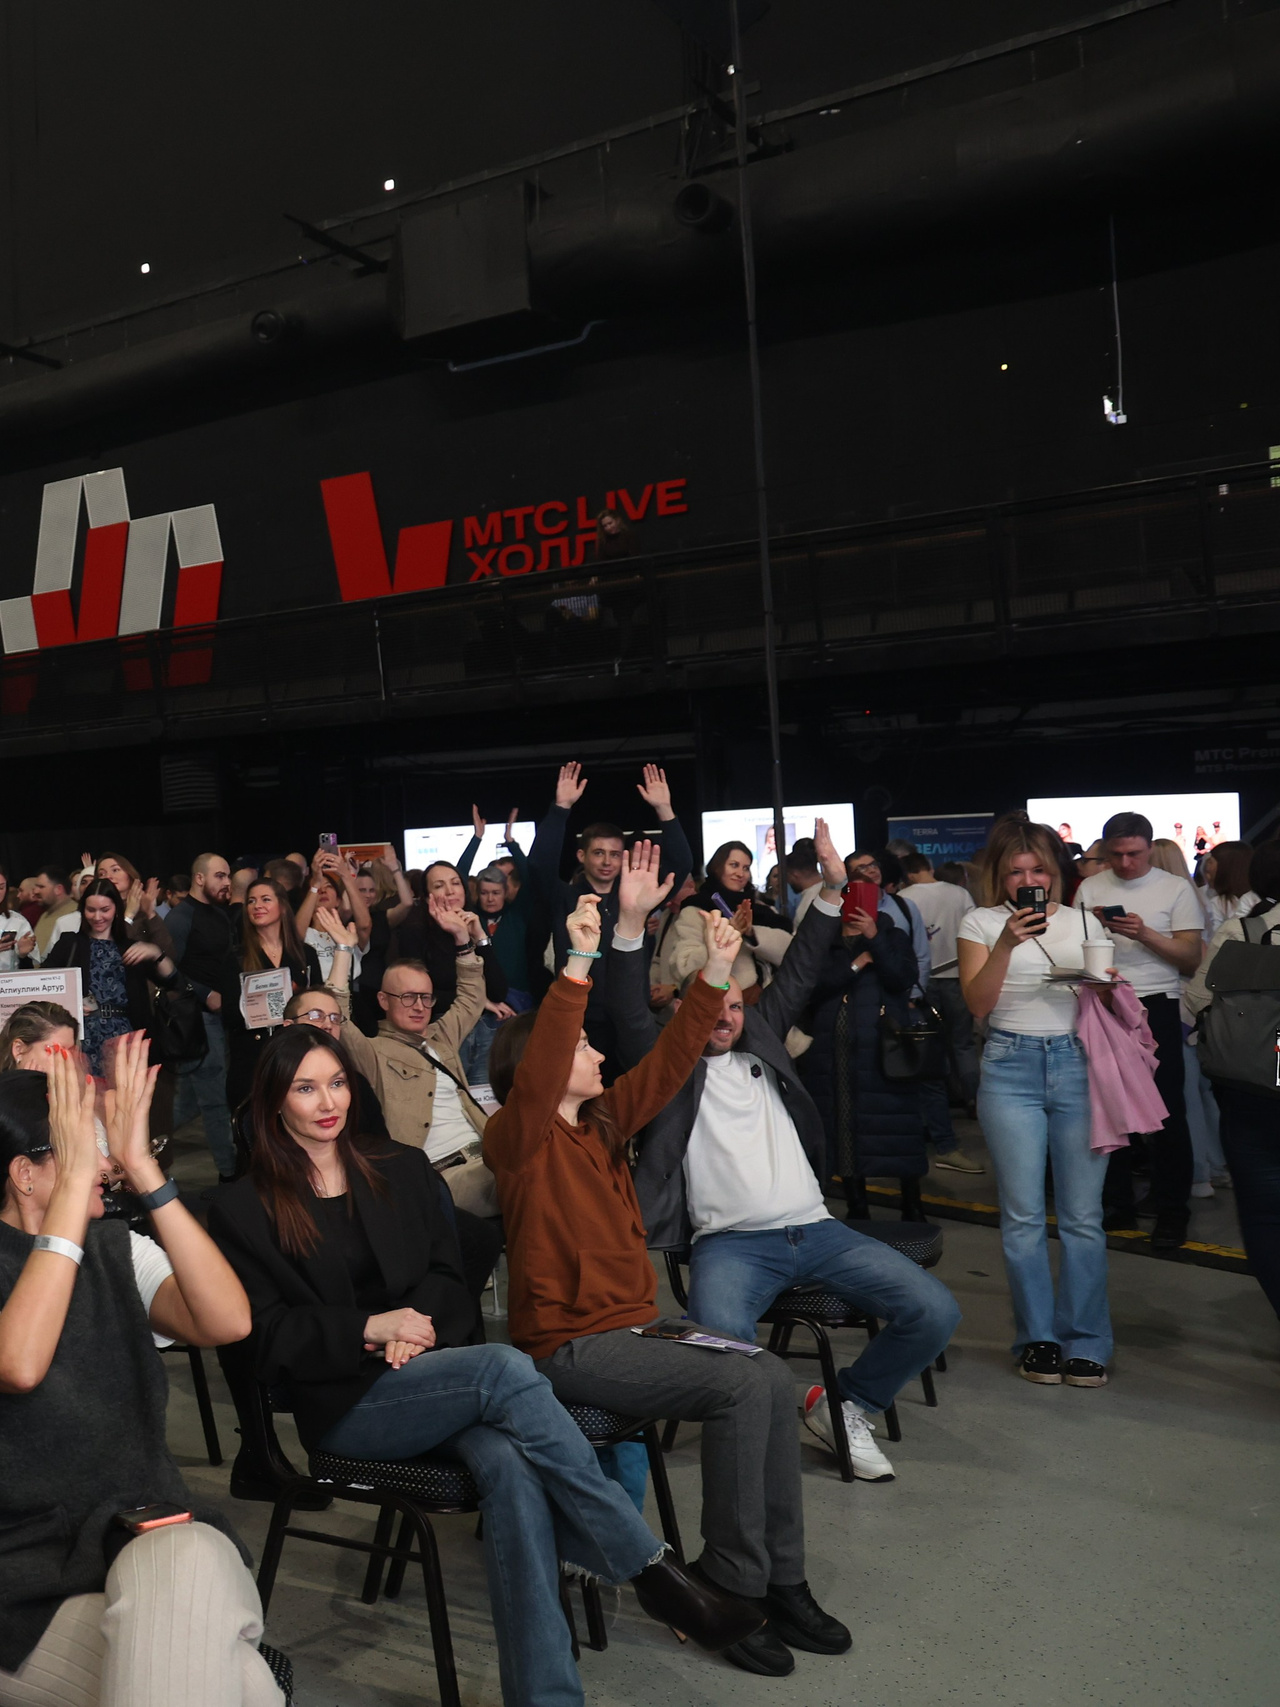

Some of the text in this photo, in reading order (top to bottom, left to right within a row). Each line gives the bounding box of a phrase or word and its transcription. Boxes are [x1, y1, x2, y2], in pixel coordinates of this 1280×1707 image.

[463, 478, 688, 548] МТС LIVE
[912, 828, 938, 836] TERRA
[0, 984, 65, 995] Аглиуллин Артур
